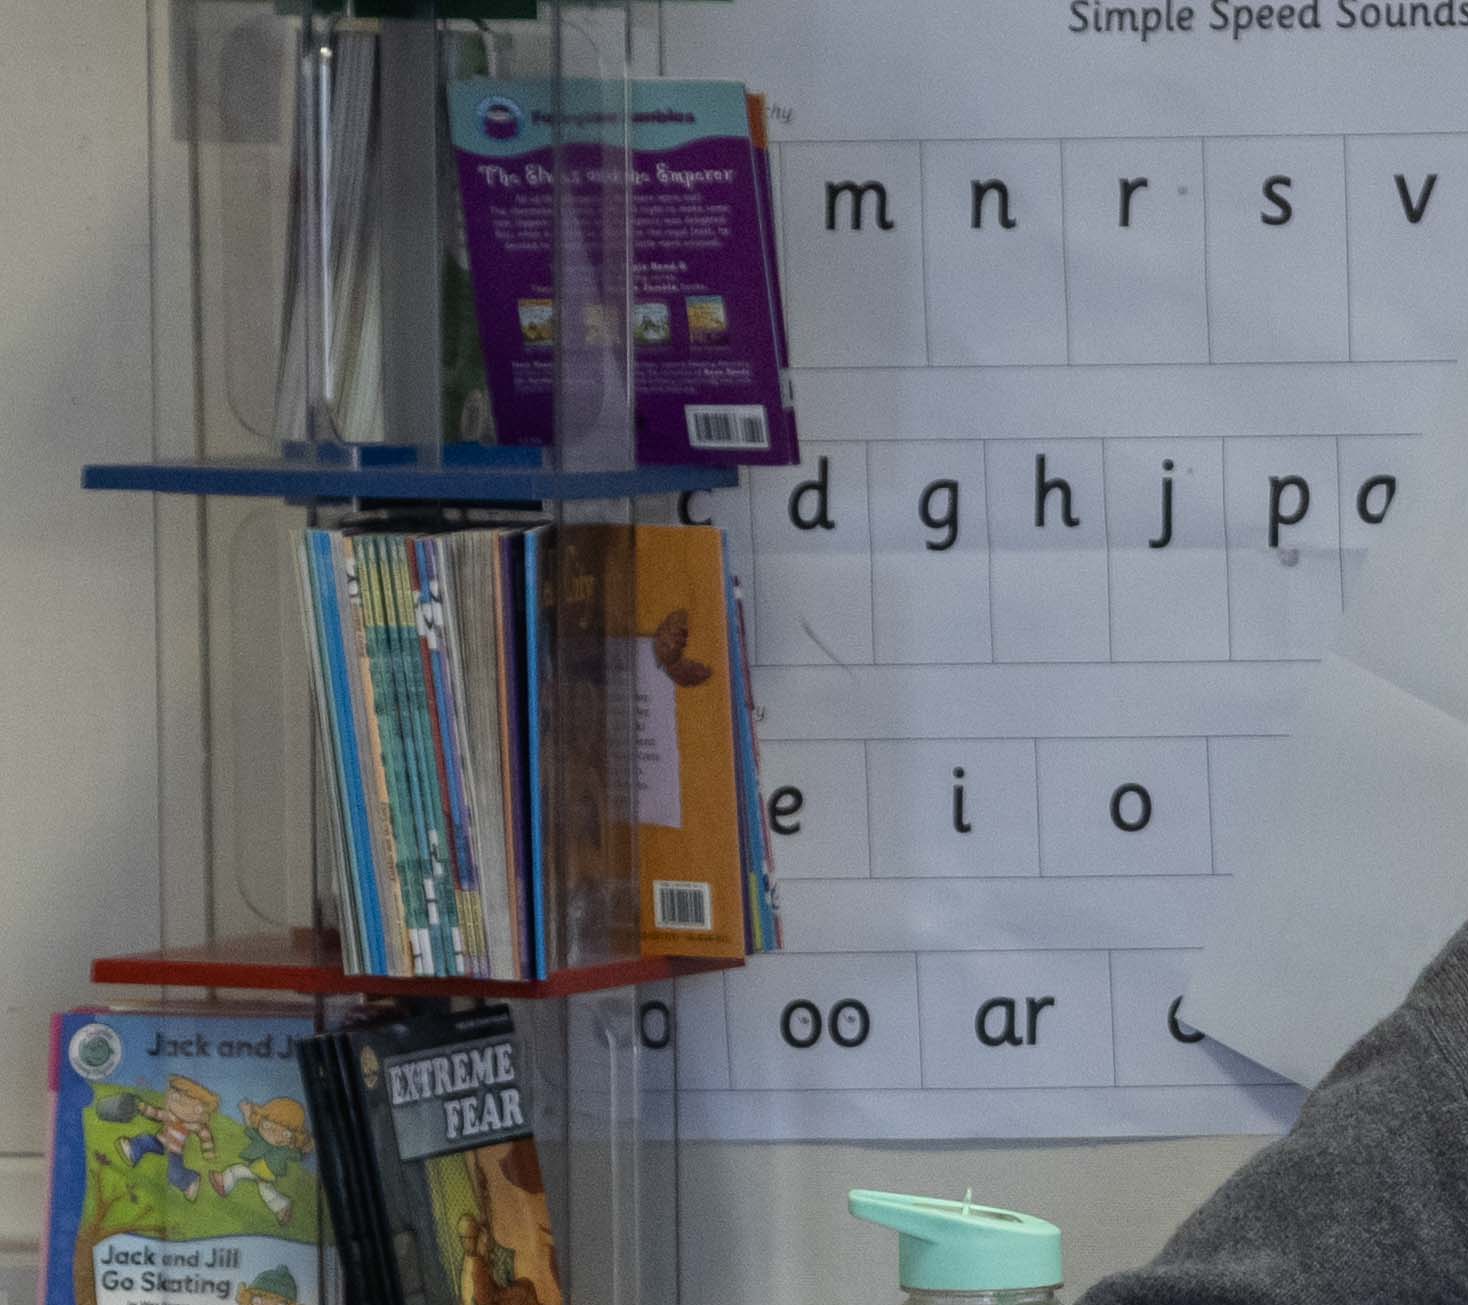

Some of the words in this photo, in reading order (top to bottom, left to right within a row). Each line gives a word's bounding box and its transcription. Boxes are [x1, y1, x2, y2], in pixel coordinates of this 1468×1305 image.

[1068, 0, 1195, 43] Simple
[1208, 0, 1322, 41] Speed
[656, 162, 735, 189] Emperor
[825, 180, 895, 232] m
[970, 178, 1017, 230] n
[1118, 177, 1149, 228] r
[1260, 175, 1294, 227] s
[1393, 173, 1438, 225] v
[788, 456, 836, 531] d
[918, 479, 960, 552] g
[1034, 453, 1081, 529] h
[1148, 459, 1175, 549] j
[1267, 475, 1311, 549] p
[767, 785, 804, 836] e
[952, 767, 972, 834] i
[1110, 782, 1153, 833] o
[147, 1031, 211, 1058] Jack
[217, 1032, 273, 1058] and
[780, 998, 872, 1050] oo
[974, 995, 1057, 1049] ar
[387, 1041, 515, 1106] EXTREME
[443, 1088, 525, 1140] FEAR
[101, 1245, 156, 1269] Jack
[162, 1248, 199, 1269] and
[205, 1247, 240, 1269] Jill
[101, 1270, 134, 1292] Go
[140, 1270, 231, 1299] Skating
